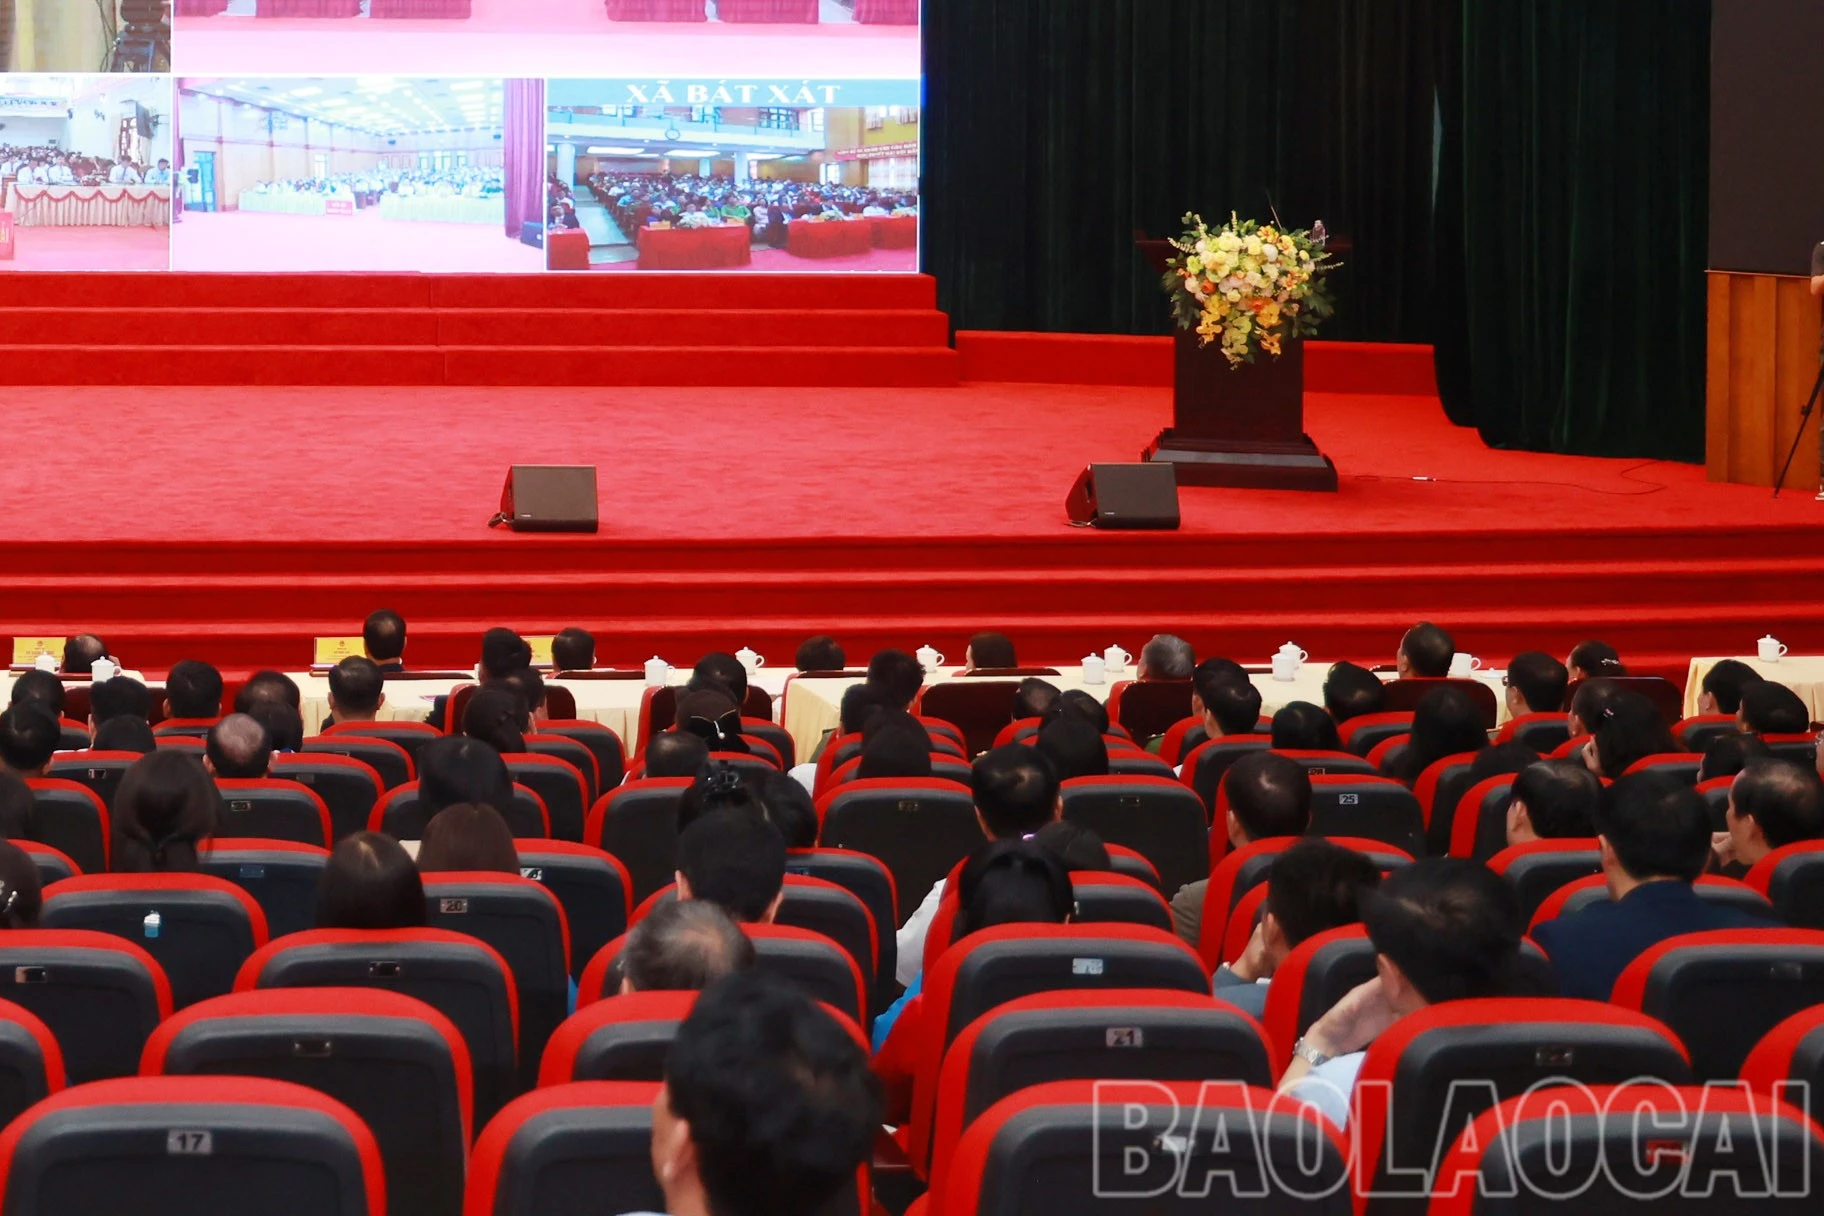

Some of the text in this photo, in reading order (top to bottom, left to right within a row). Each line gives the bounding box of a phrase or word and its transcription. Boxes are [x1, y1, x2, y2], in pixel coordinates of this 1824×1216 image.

[626, 80, 841, 104] XÃ BÁT XÁT
[1342, 795, 1355, 804] 25
[446, 900, 463, 912] 20
[177, 1133, 203, 1151] 17
